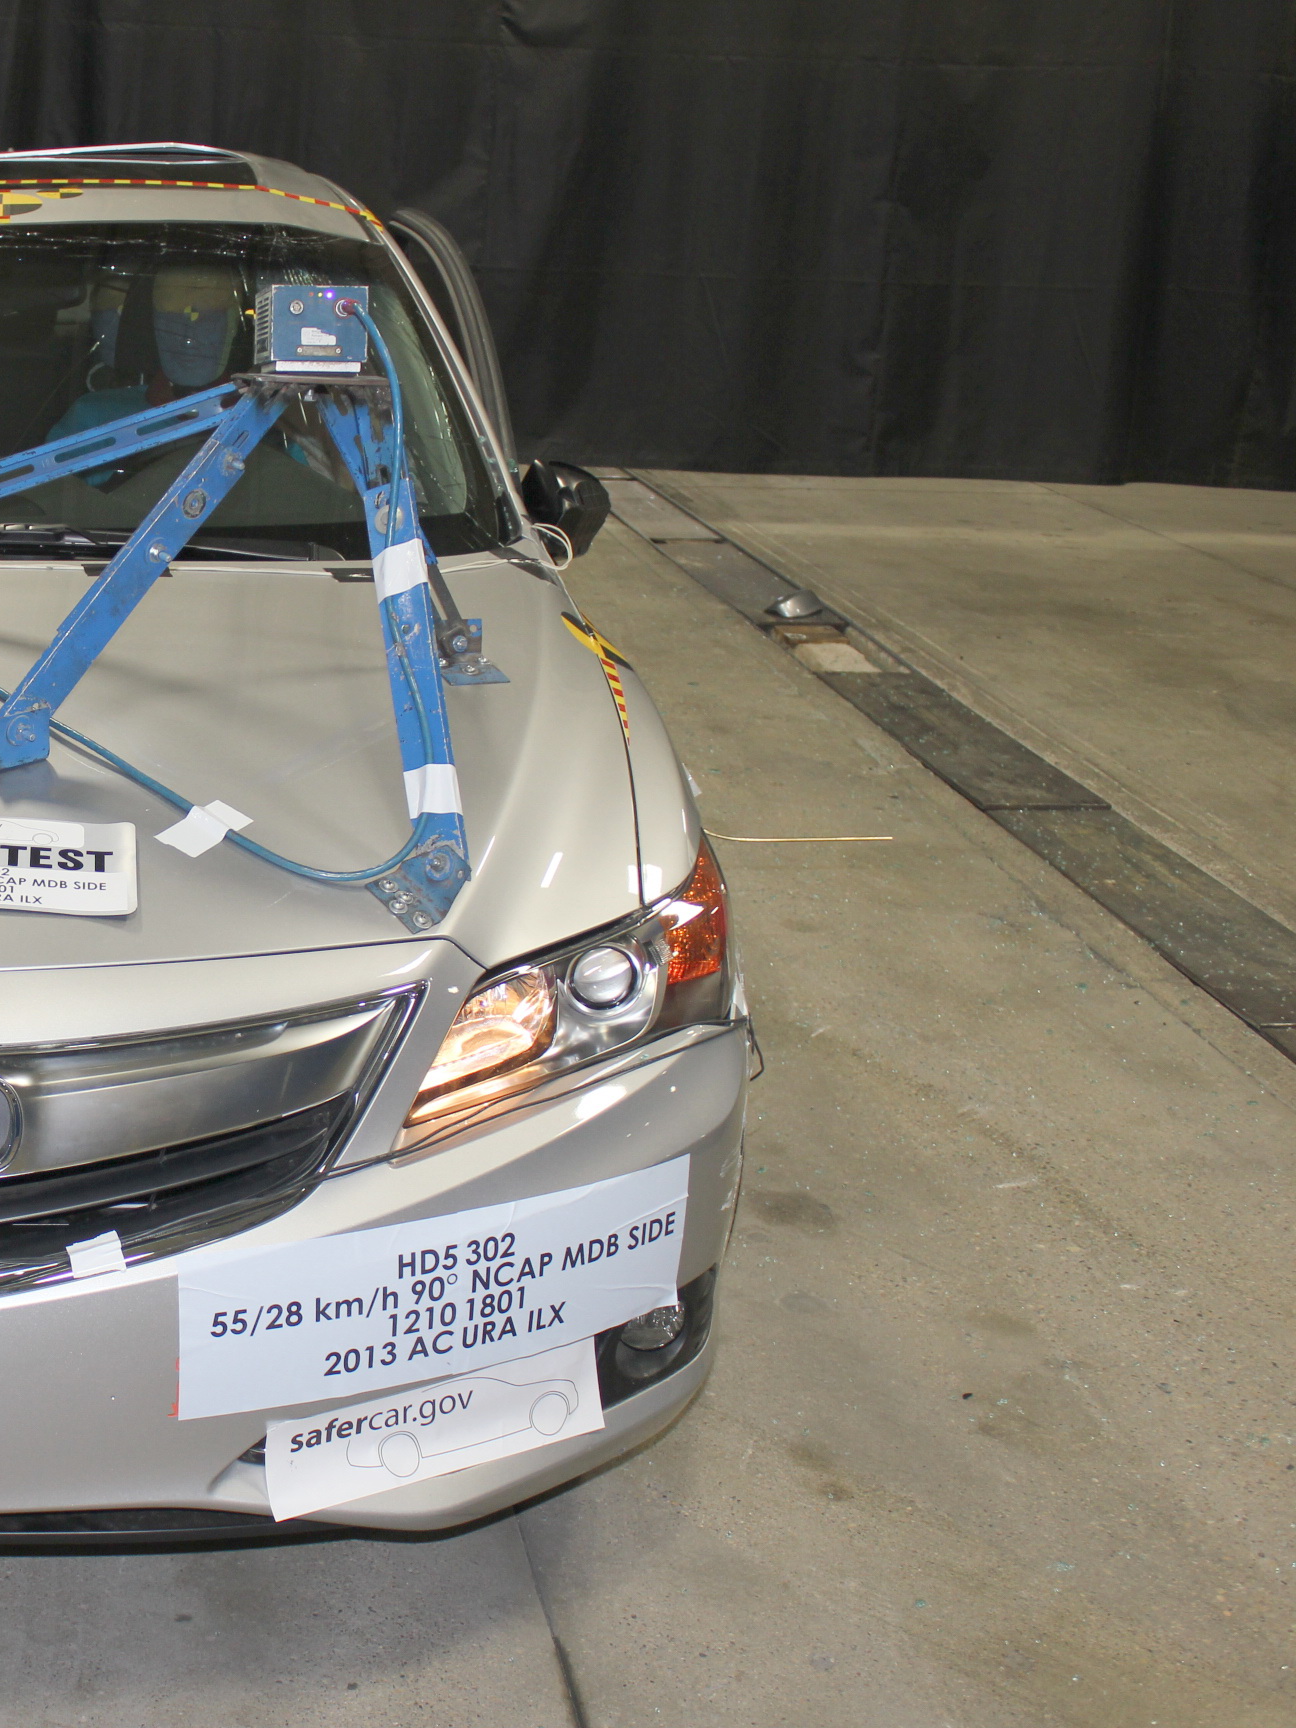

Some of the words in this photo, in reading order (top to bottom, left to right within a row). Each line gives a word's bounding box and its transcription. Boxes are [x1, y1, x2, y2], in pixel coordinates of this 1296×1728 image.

[20, 895, 43, 904] ILX
[32, 879, 68, 889] MDB
[73, 881, 107, 891] SIDE
[210, 1301, 304, 1338] 55/28
[314, 1286, 399, 1323] km/h
[471, 1253, 553, 1293] NCAP
[561, 1233, 619, 1272] MDB
[627, 1211, 676, 1251] SIDE
[323, 1340, 397, 1377] 2013
[527, 1302, 567, 1334] ILX
[289, 1389, 474, 1453] safercar.gov
